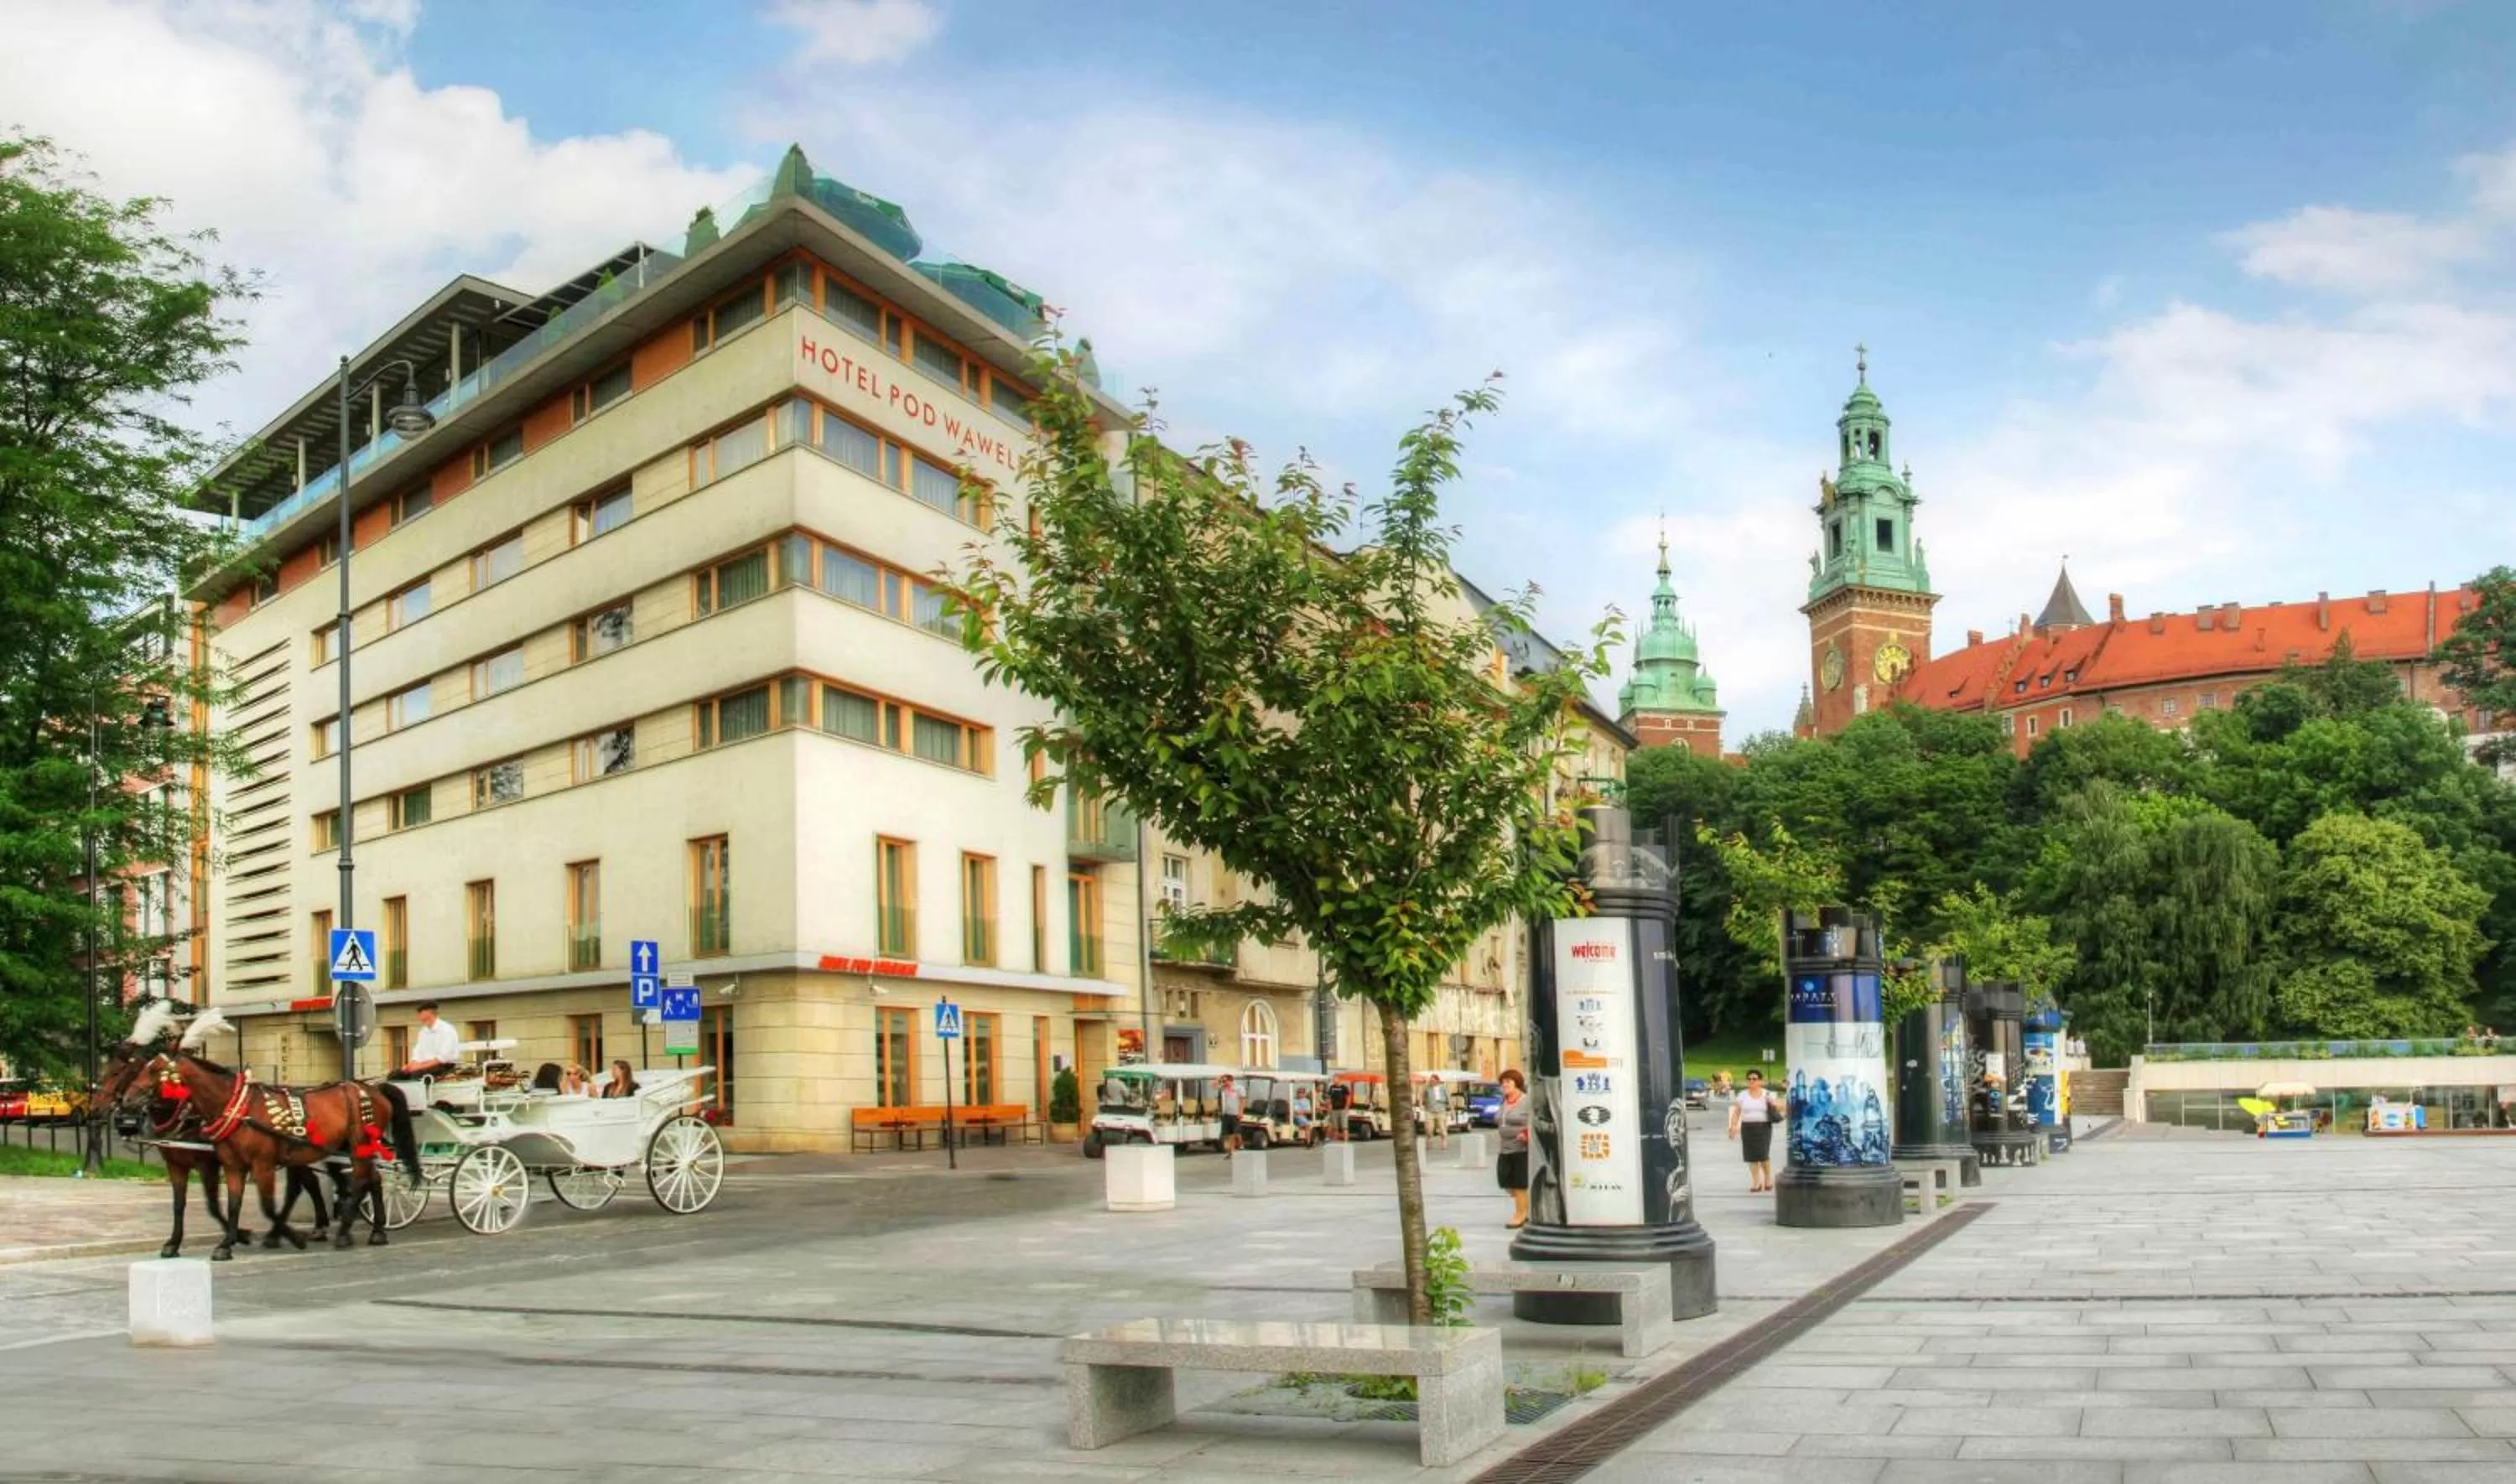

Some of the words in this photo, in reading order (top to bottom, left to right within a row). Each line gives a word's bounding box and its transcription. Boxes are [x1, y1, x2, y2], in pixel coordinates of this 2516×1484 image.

[802, 335, 881, 398] HOTEL
[890, 384, 937, 426] POD
[944, 410, 1015, 470] WAWEL
[638, 978, 654, 1004] P
